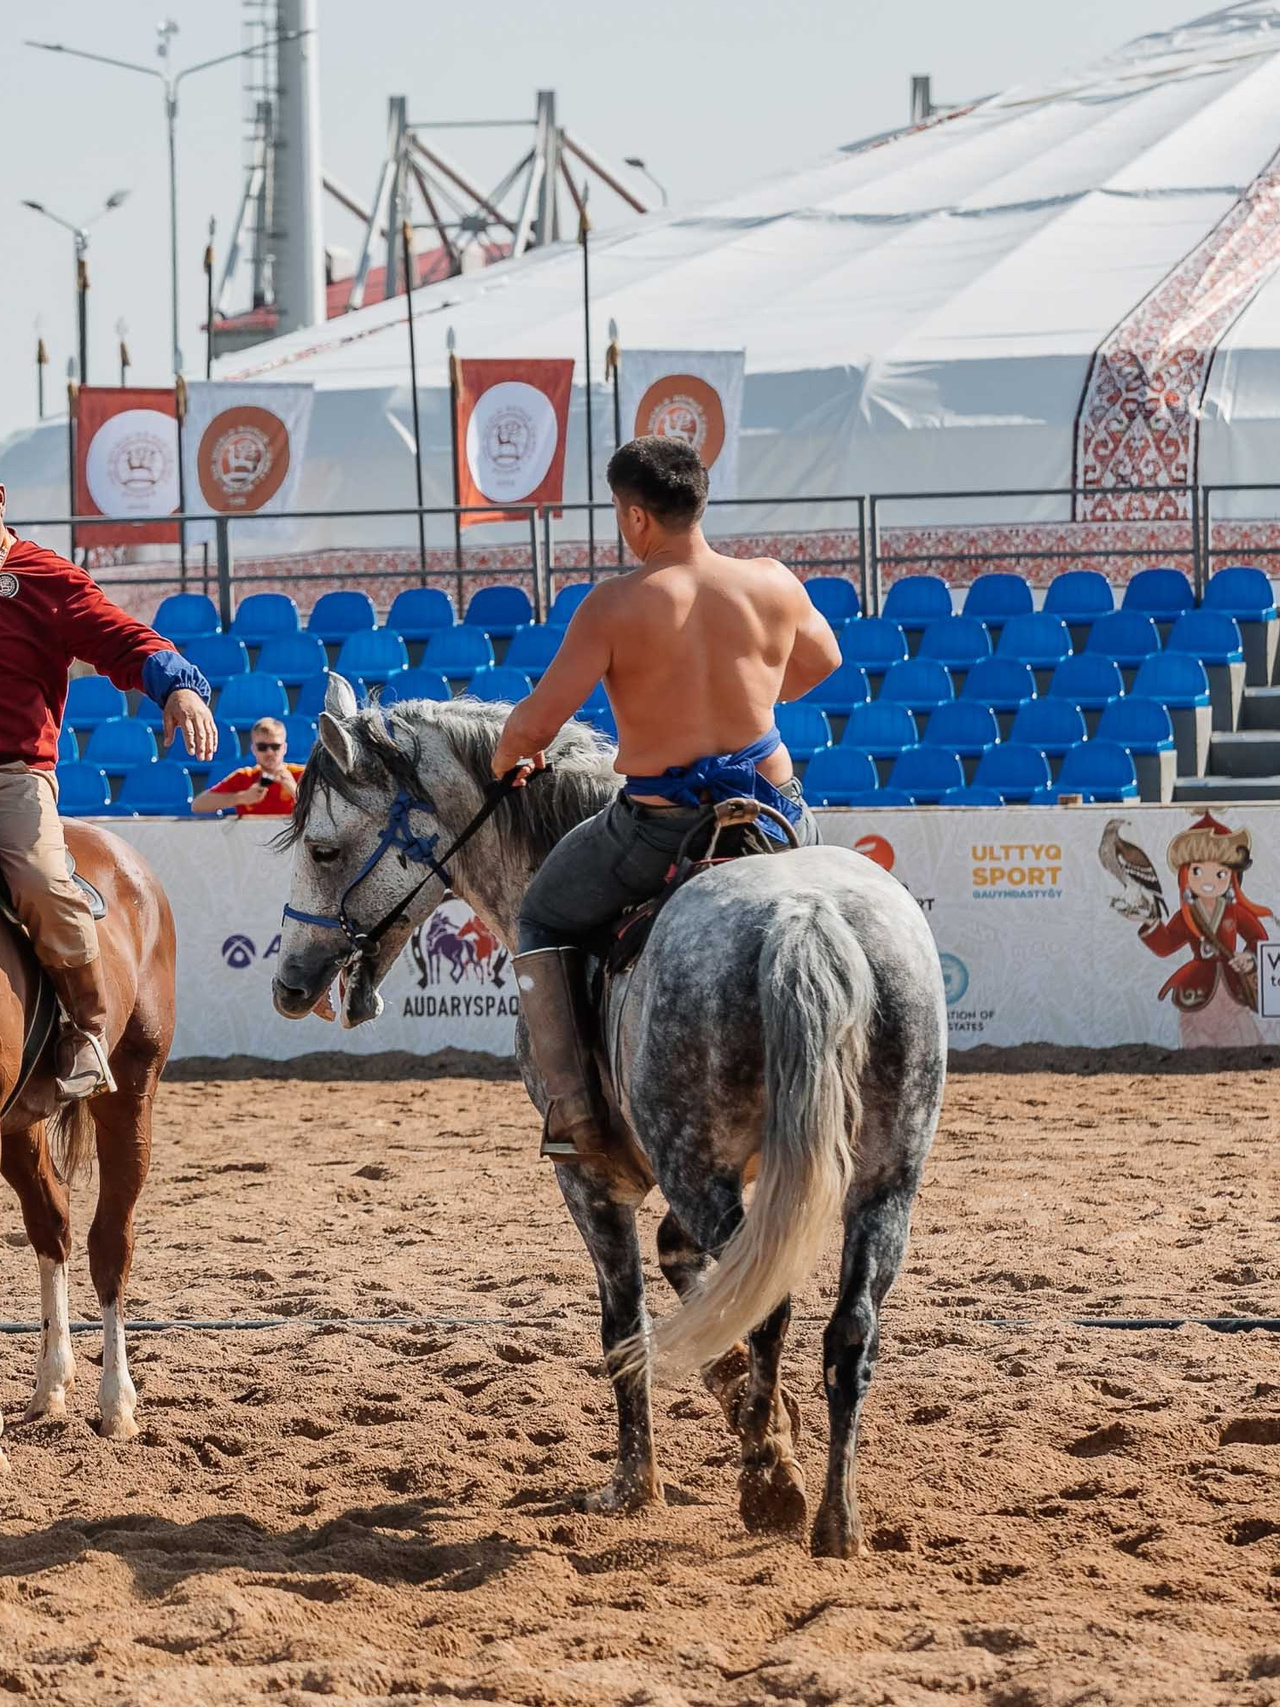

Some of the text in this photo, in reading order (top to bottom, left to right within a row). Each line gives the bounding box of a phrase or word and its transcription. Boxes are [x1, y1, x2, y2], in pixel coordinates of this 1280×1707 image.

[972, 844, 1062, 861] ULTTYQ
[972, 866, 1062, 886] SPORT
[403, 995, 519, 1018] AUDARYSPAQ
[947, 1010, 994, 1020] TION OF
